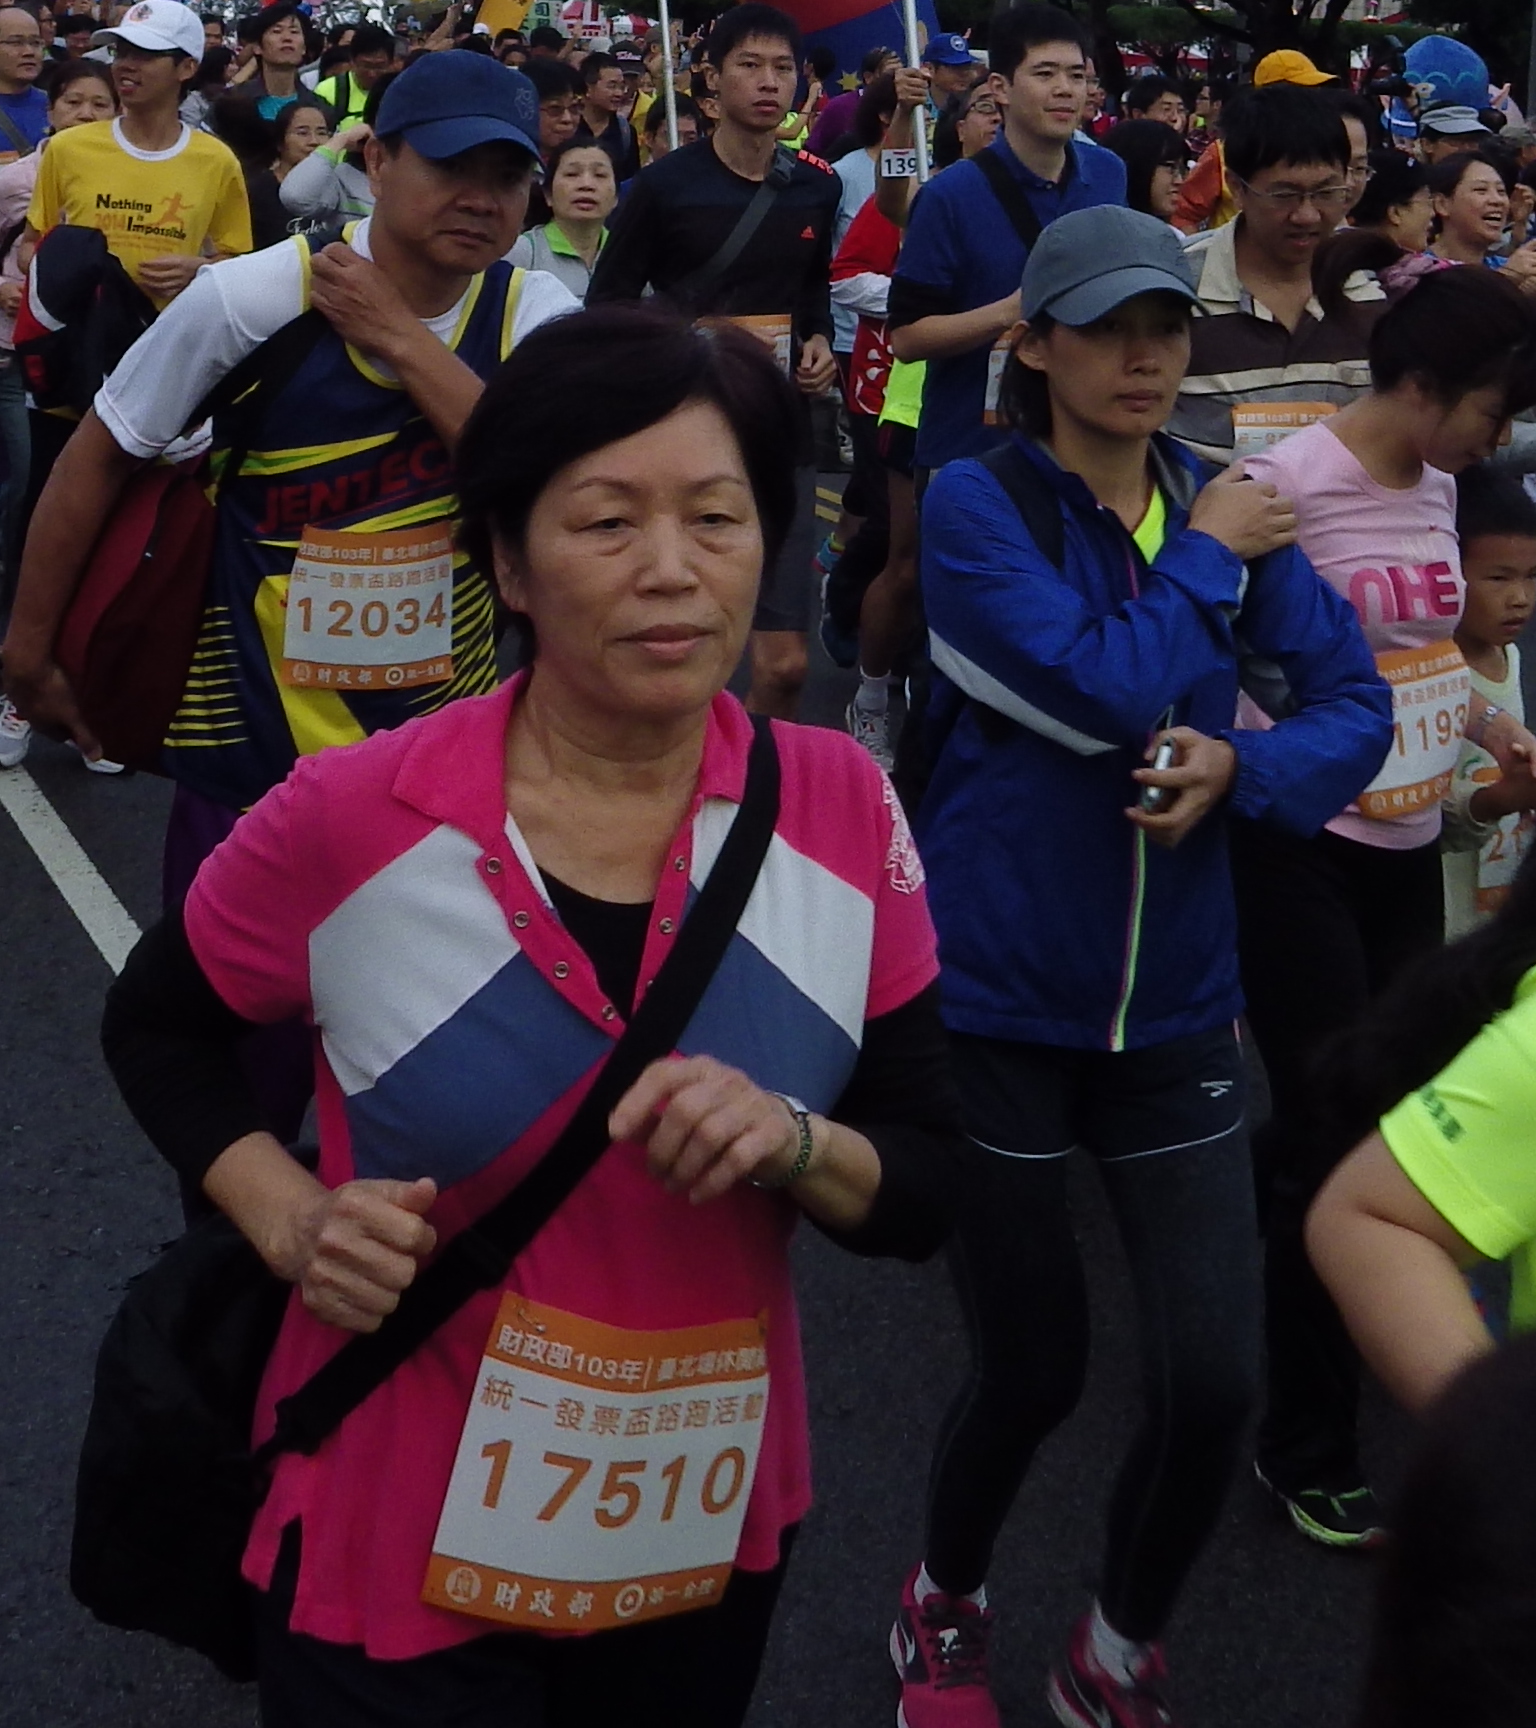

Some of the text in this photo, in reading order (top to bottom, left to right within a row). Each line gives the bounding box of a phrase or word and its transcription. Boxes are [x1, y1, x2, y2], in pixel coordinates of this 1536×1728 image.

[96, 193, 153, 213] Nothing
[127, 215, 187, 240] Impossible
[296, 592, 447, 638] 12034
[479, 1438, 746, 1530] 17510
[493, 1580, 595, 1618] 財政部
